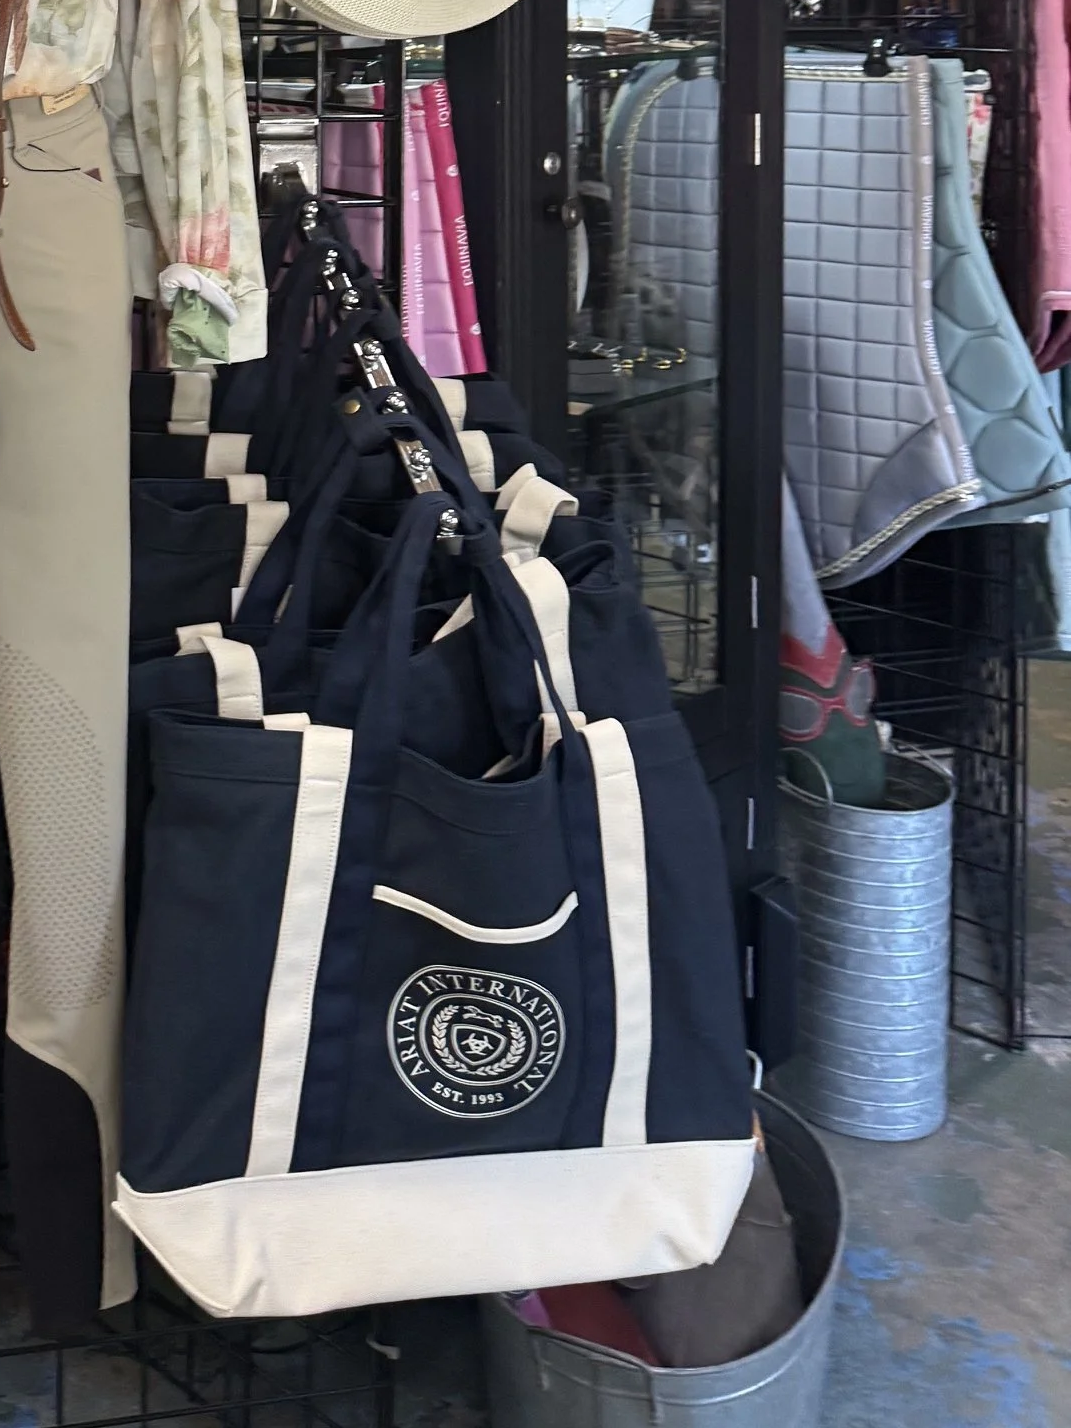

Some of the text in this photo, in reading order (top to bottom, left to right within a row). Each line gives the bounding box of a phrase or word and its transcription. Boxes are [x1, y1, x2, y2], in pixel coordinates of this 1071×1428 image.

[455, 214, 474, 286] EQUINAVIA
[397, 973, 558, 1094] ARIAT INTERNATIONAL
[431, 1082, 505, 1105] EST. 1993
